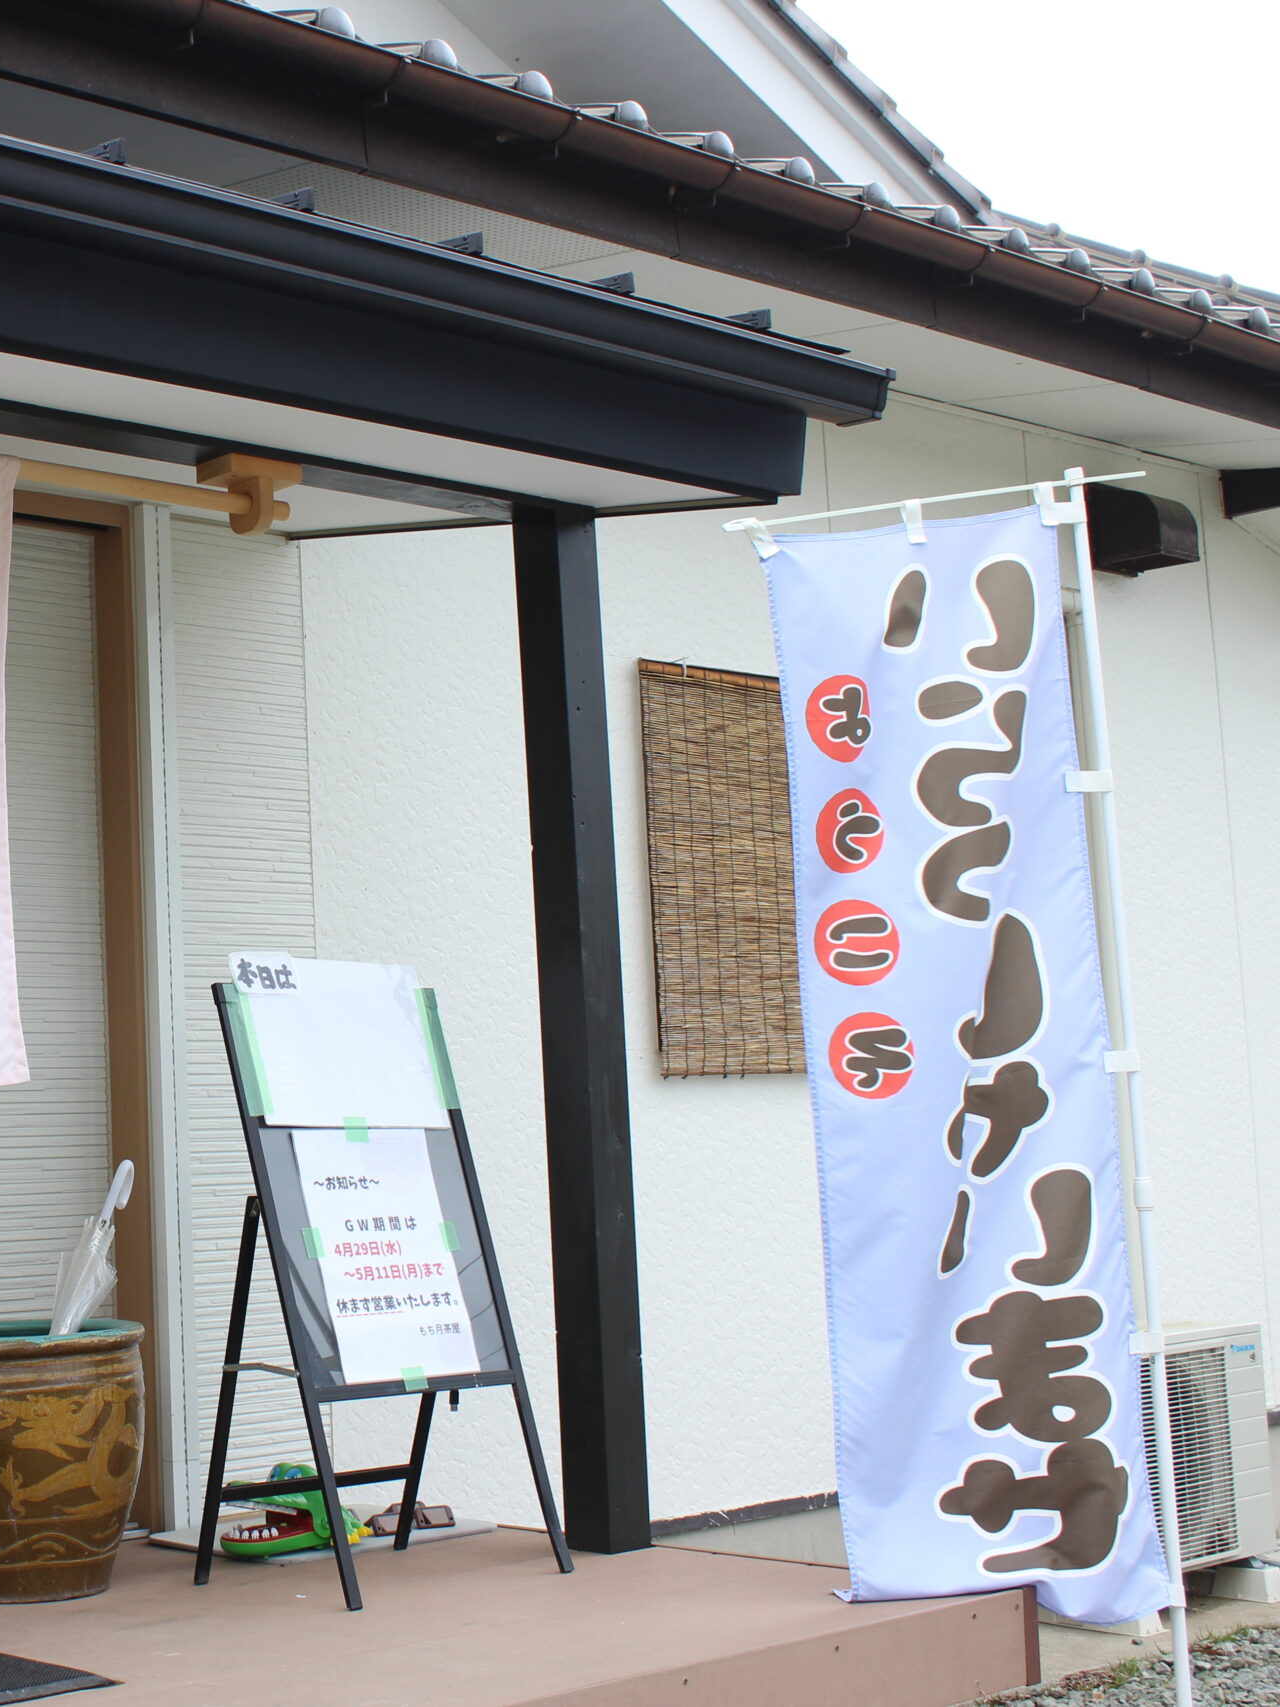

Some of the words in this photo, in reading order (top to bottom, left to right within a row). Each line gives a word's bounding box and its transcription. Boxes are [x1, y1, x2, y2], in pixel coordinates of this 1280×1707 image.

[236, 958, 297, 990] 本日は
[334, 1240, 402, 1258] 4月29日(水)
[336, 1291, 460, 1314] 休まず営業いたします。
[419, 1322, 462, 1336] もち月茶屋
